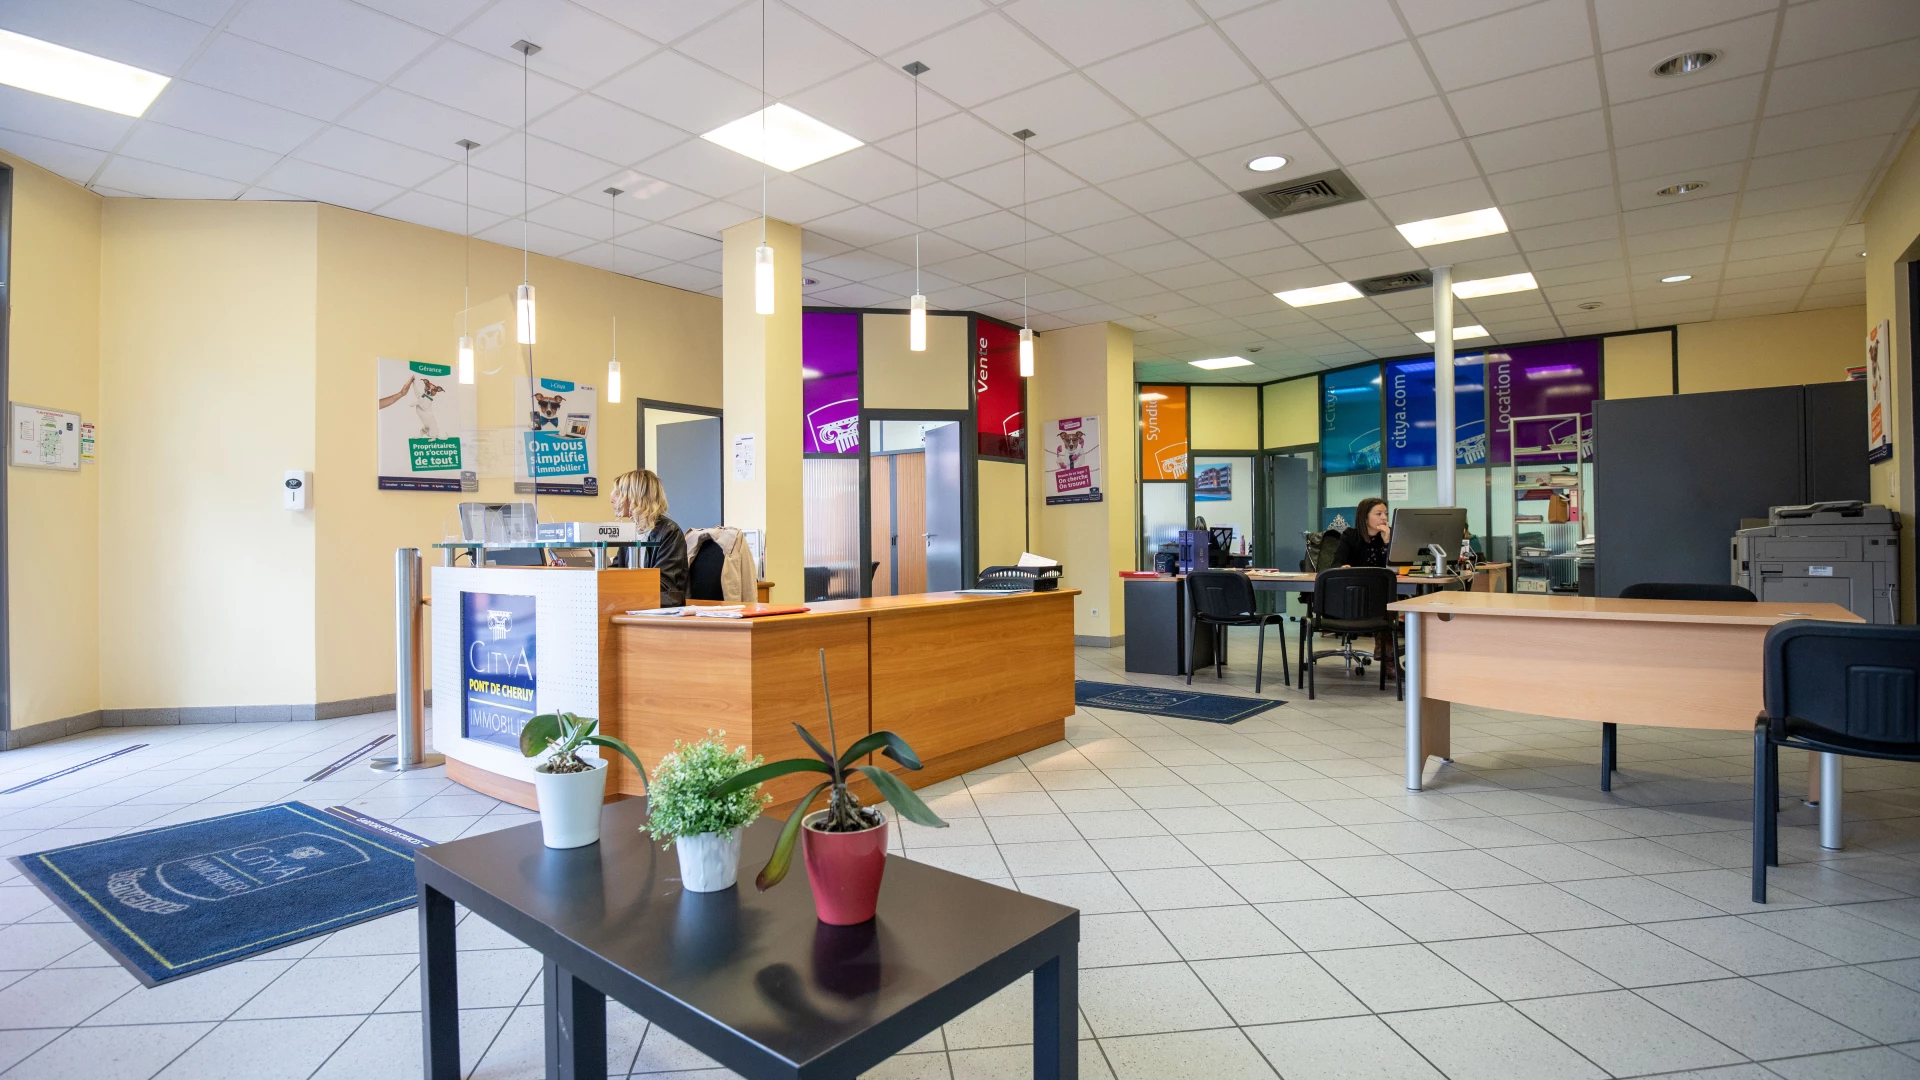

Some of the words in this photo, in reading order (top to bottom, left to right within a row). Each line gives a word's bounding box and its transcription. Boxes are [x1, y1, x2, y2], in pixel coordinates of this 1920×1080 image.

[418, 365, 442, 374] Gérance
[978, 337, 988, 393] Vente
[1493, 363, 1511, 433] Location
[1146, 397, 1161, 441] Syndic
[1391, 374, 1410, 449] citya.com
[413, 443, 457, 451] Propriétaires,
[528, 440, 549, 452] On
[552, 441, 583, 451] vous
[415, 457, 428, 466] de
[430, 457, 453, 465] tout
[530, 451, 584, 466] simplifie
[1067, 474, 1088, 482] cherche
[1068, 480, 1086, 488] trouve
[598, 528, 620, 537] tecno
[469, 678, 489, 694] PONT
[490, 683, 501, 696] DE
[501, 684, 534, 702] CHERUY
[470, 709, 529, 737] IMMOBILIE
[183, 859, 251, 893] IMMOBILIER
